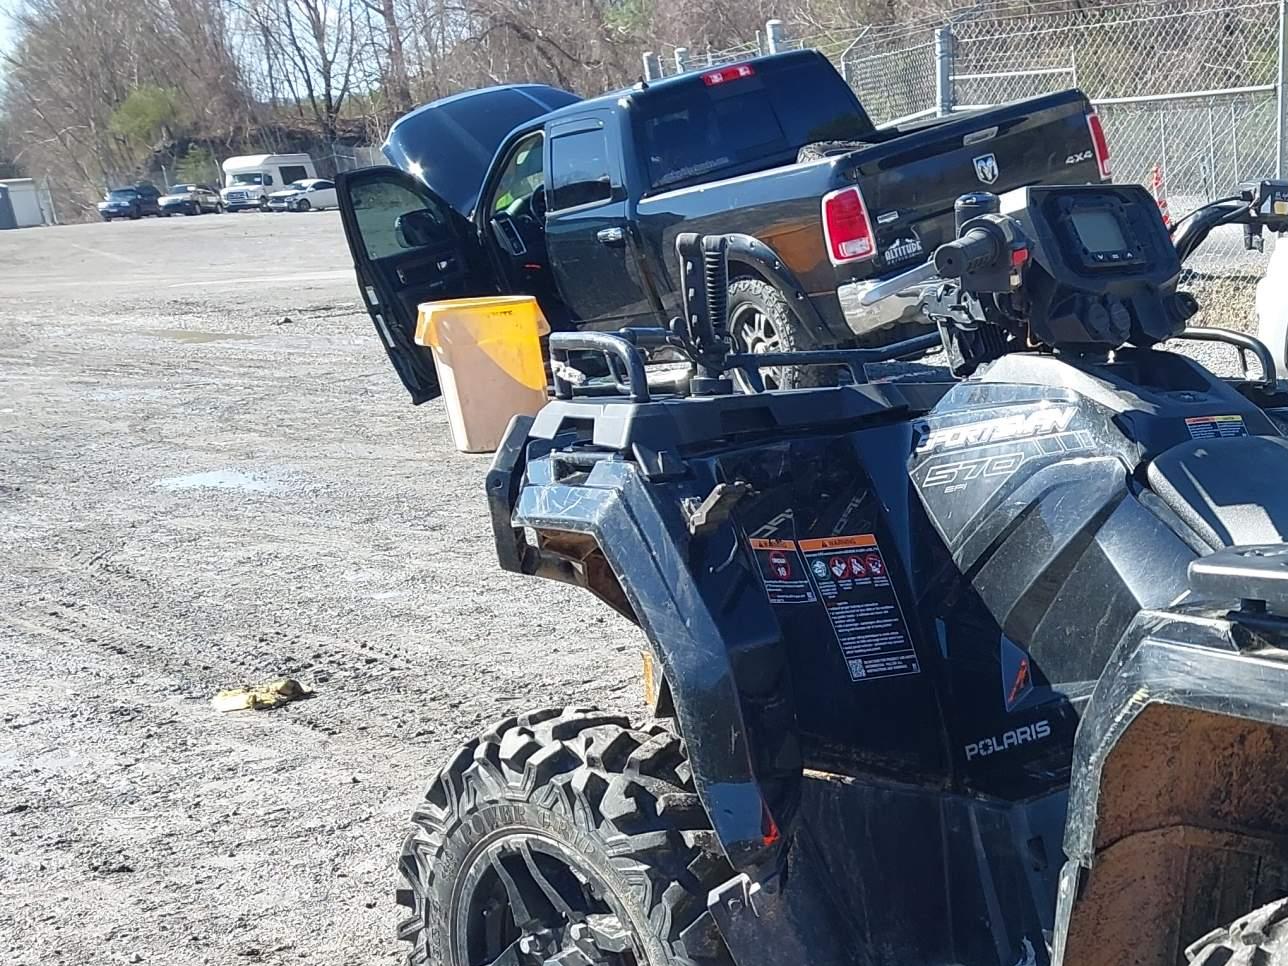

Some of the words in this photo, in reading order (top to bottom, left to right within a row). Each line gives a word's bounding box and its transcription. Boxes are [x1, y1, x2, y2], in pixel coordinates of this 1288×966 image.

[884, 240, 923, 261] ALTITUDE
[922, 452, 1025, 488] 570
[964, 719, 1051, 761] POLARIS
